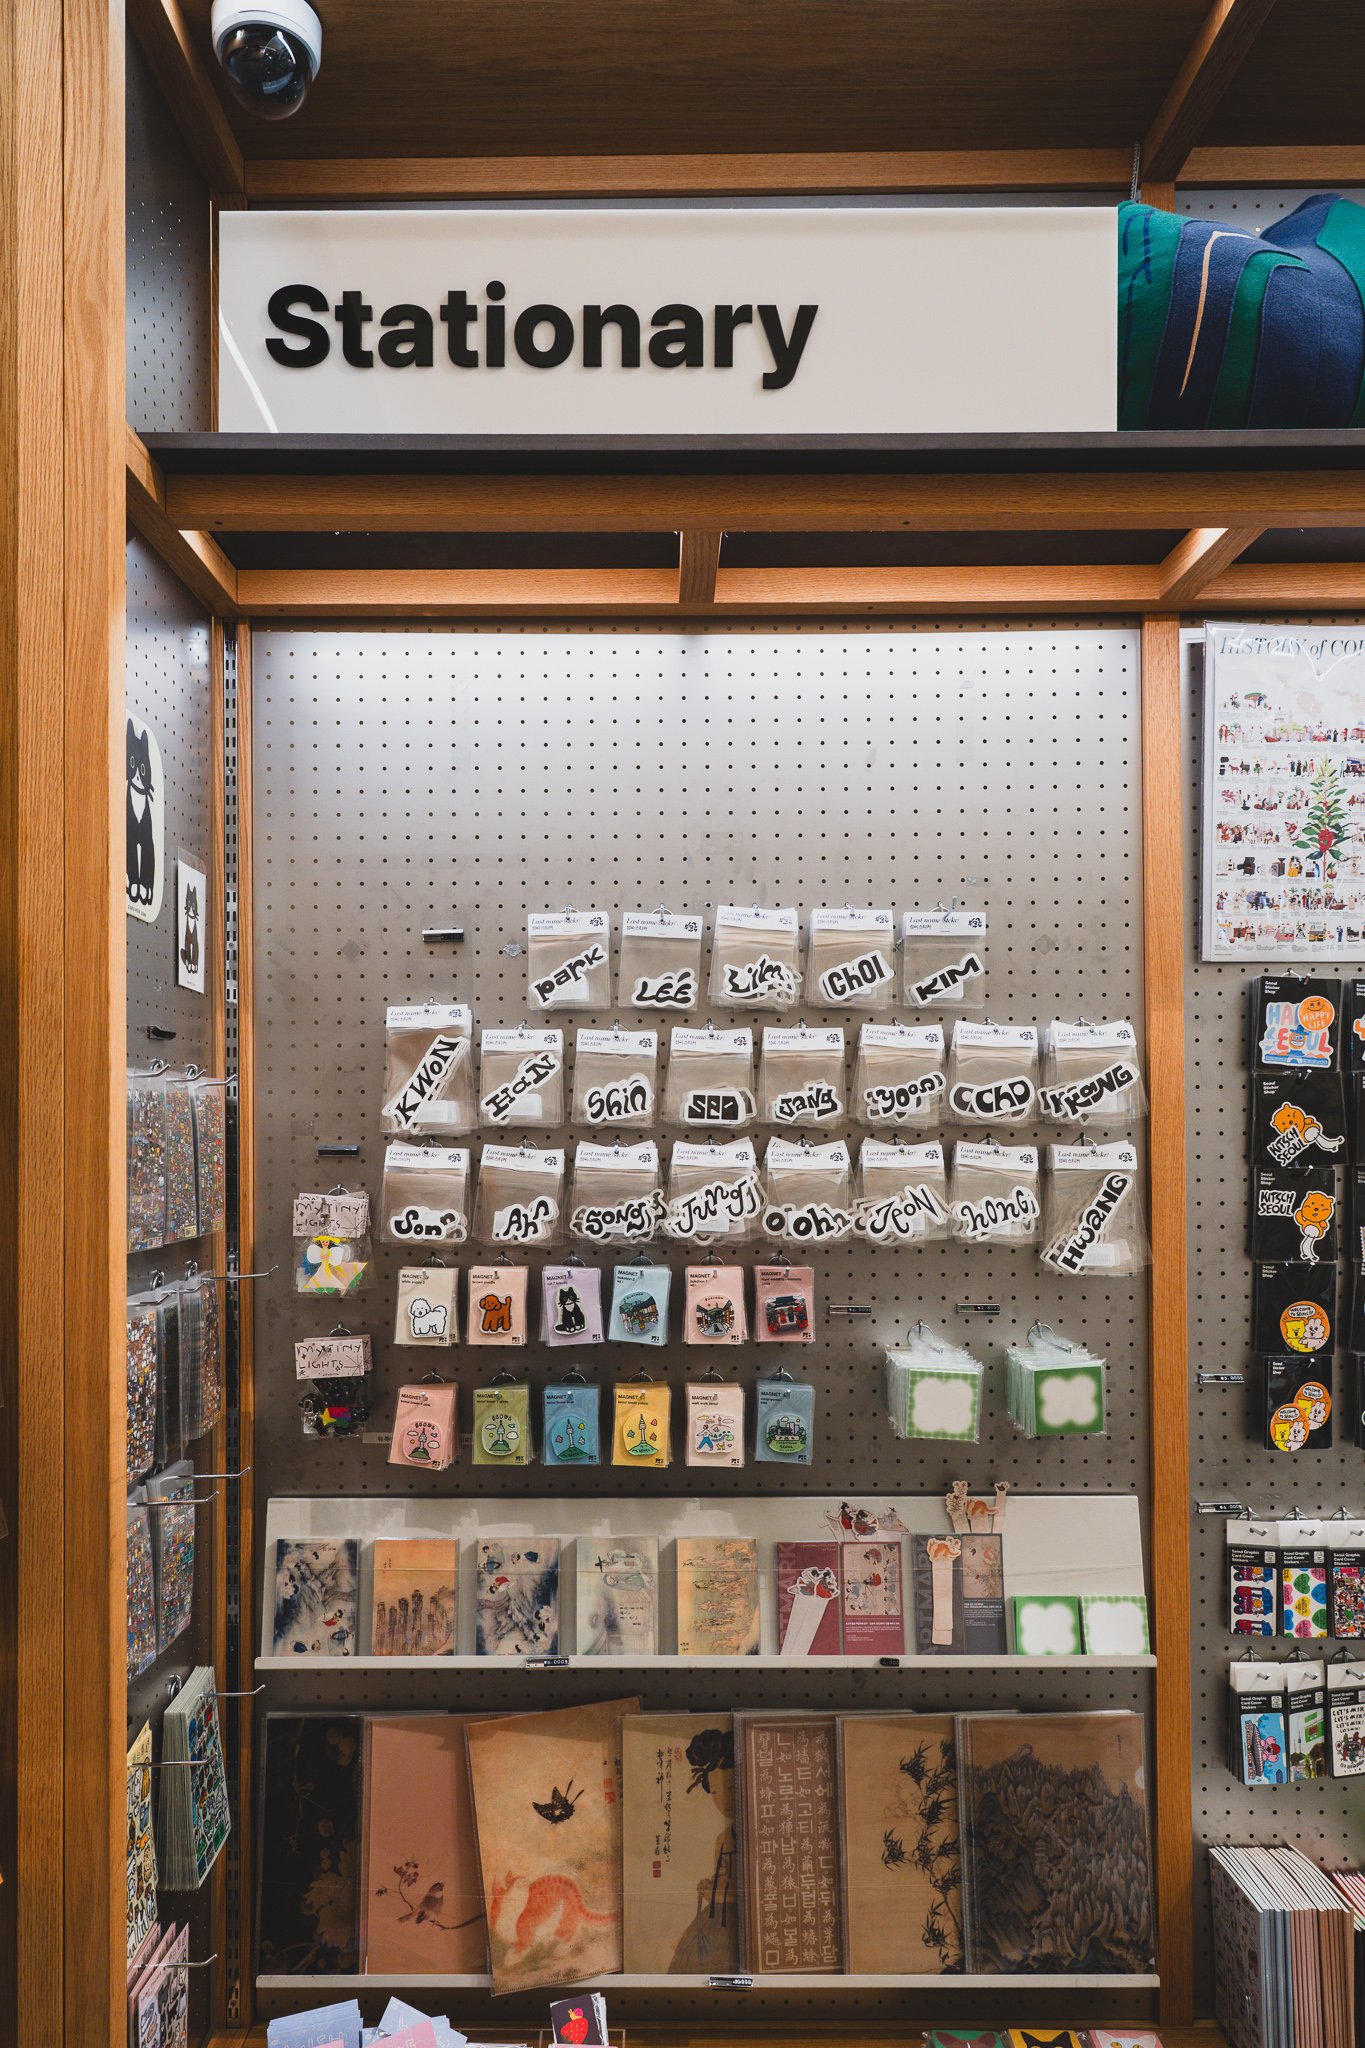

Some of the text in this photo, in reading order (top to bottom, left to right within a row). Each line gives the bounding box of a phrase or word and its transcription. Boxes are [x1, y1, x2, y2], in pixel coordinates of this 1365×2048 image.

[265, 280, 818, 389] Stationary
[1310, 640, 1328, 660] of
[1330, 640, 1365, 656] CO
[916, 957, 980, 1001] KIM
[1303, 1011, 1330, 1023] HAPPY
[1308, 1020, 1326, 1029] LIFE
[1270, 1127, 1299, 1156] KITSCH
[1277, 1140, 1306, 1165] SEOUL
[1261, 1192, 1294, 1203] KITSCH
[1260, 1203, 1292, 1215] SEOUL
[299, 1360, 343, 1369] LIGHTS
